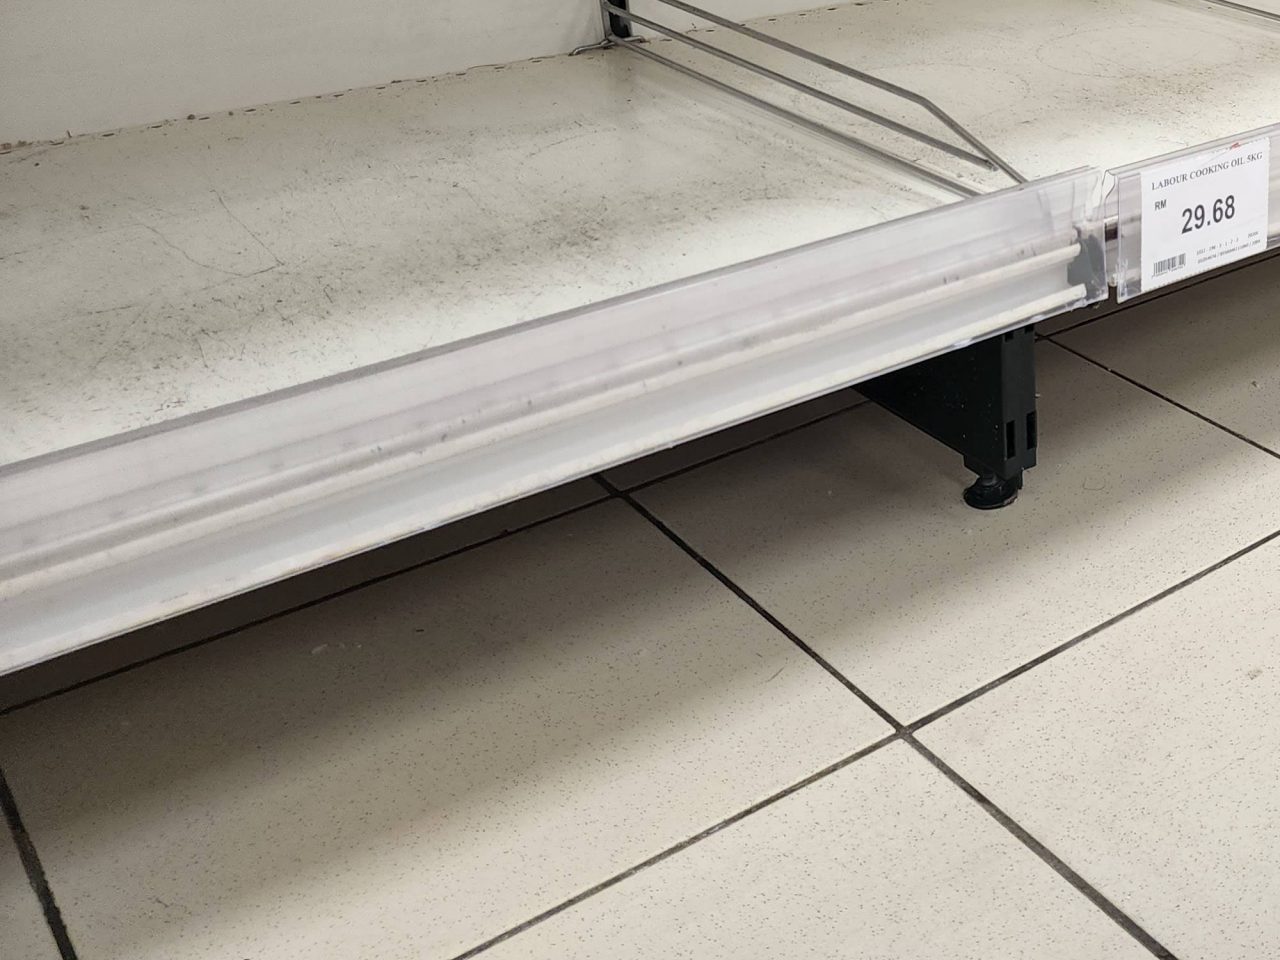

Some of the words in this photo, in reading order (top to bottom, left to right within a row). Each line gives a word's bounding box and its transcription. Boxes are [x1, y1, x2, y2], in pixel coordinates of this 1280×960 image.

[1152, 174, 1188, 191] LABOUR
[1190, 162, 1230, 180] COOKING
[1231, 157, 1245, 168] OIL
[1246, 151, 1263, 164] 5KG
[1154, 199, 1167, 211] RM
[1181, 194, 1236, 235] 29.68
